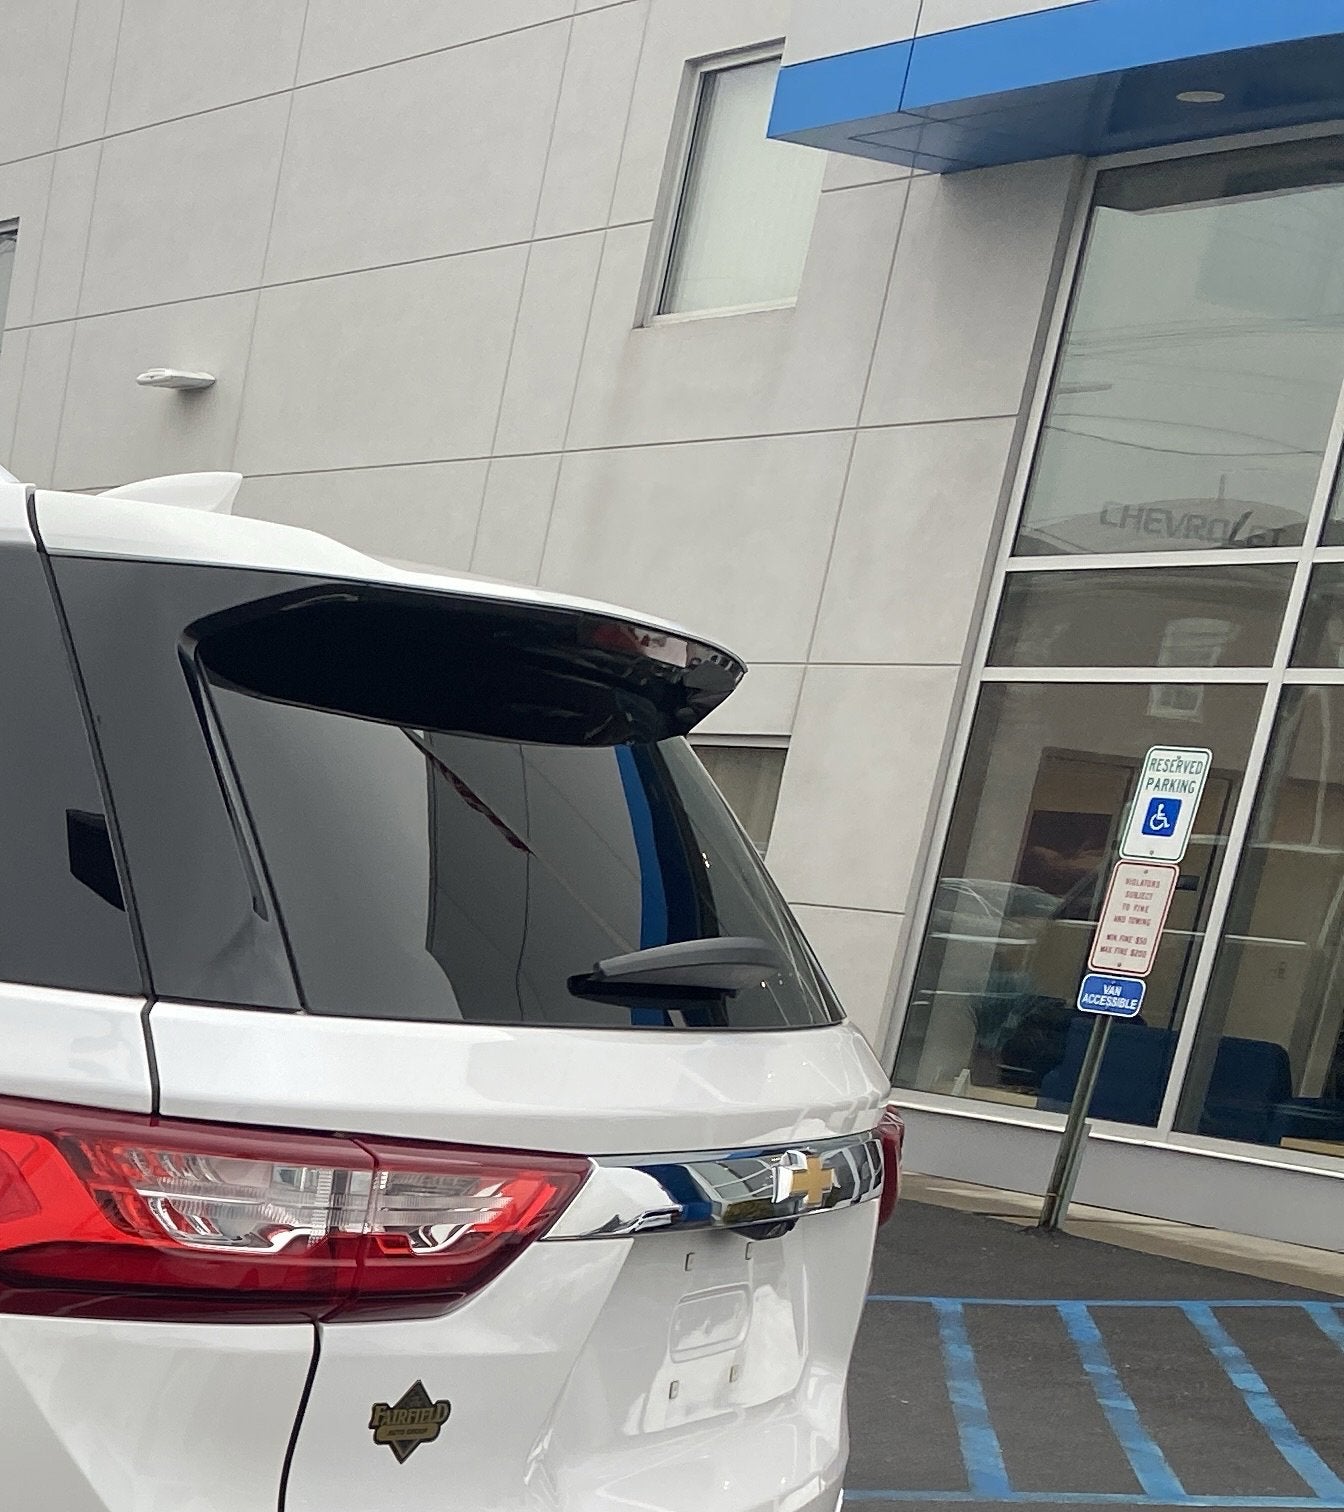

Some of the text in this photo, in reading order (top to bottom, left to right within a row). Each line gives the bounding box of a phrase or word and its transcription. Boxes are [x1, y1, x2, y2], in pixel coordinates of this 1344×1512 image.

[1148, 757, 1204, 775] RESERVED
[1145, 777, 1196, 794] PARKING
[1125, 878, 1161, 889] VIOLATORS
[1122, 902, 1150, 914] TO FINE
[1113, 915, 1127, 923] AND
[1103, 984, 1122, 997] VAN
[1081, 993, 1139, 1010] ACCESSIBLE
[372, 1403, 447, 1426] FAIRFIELD
